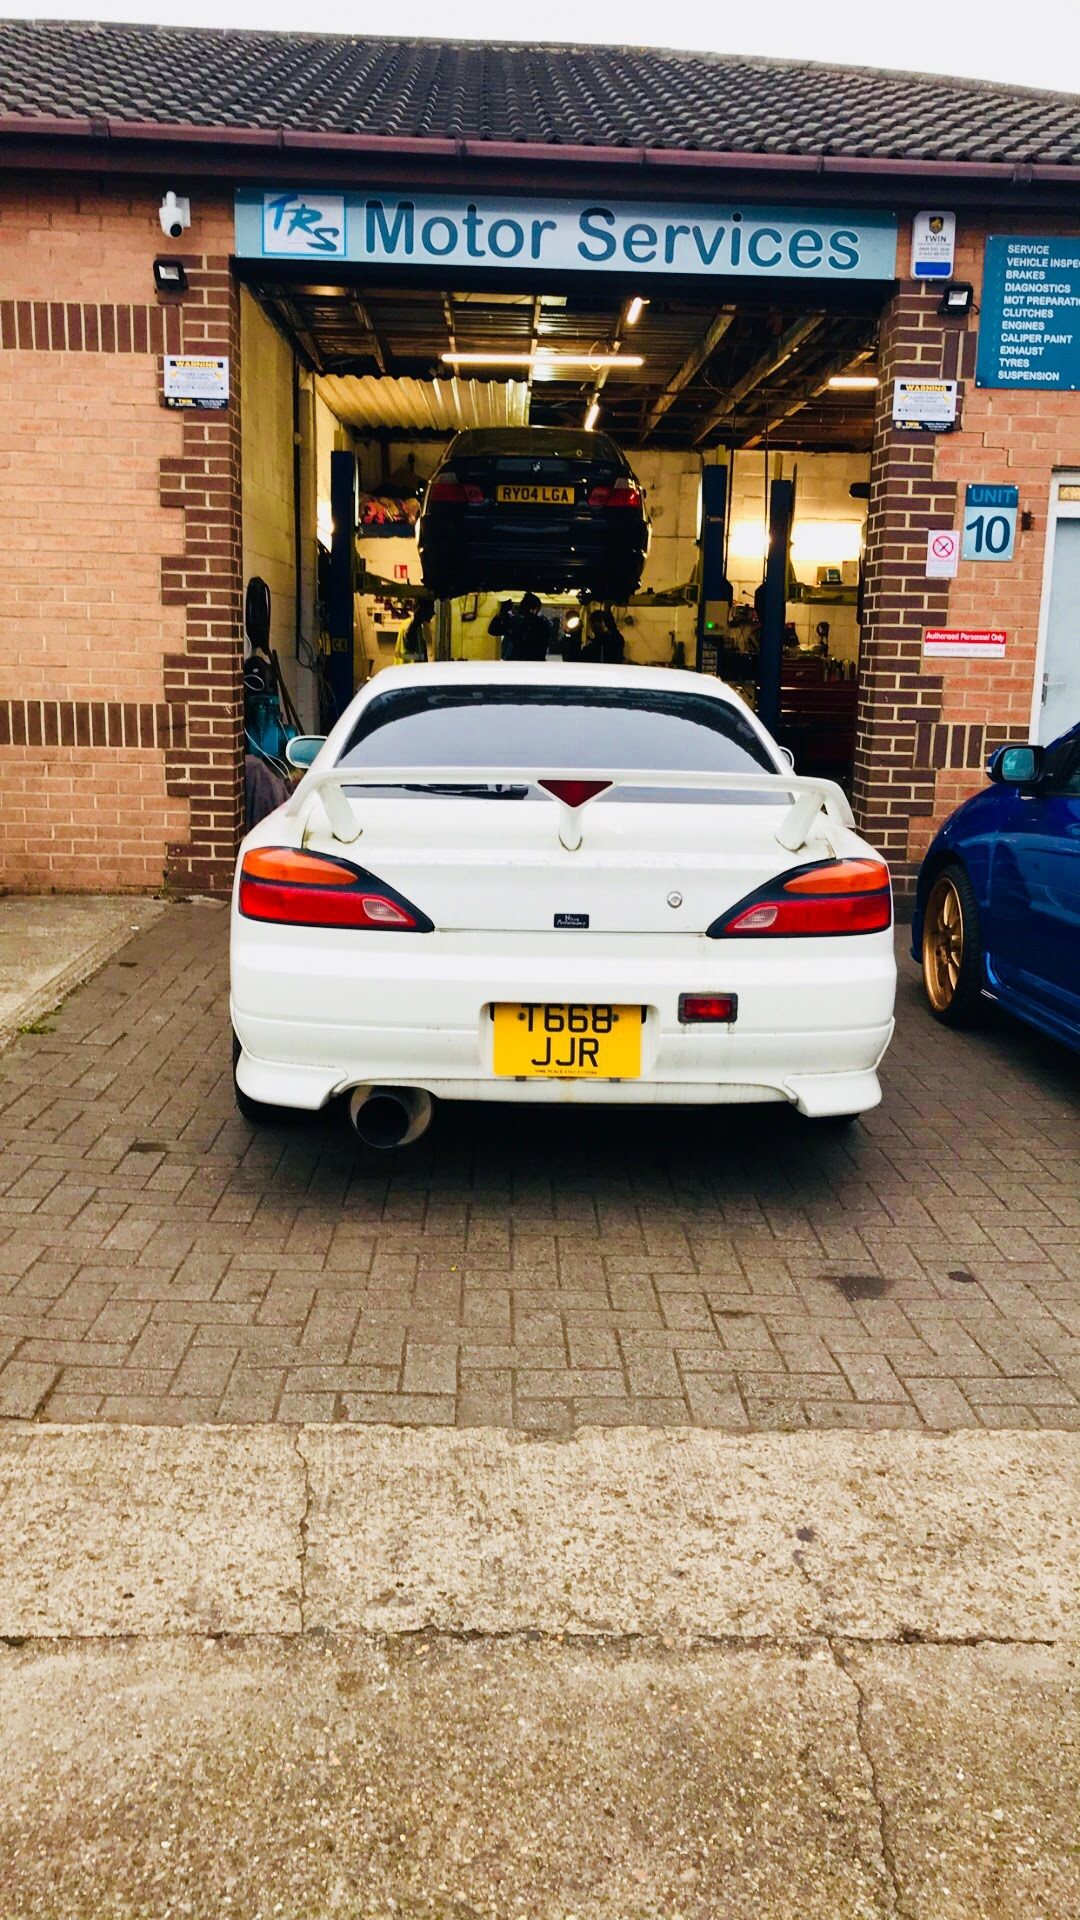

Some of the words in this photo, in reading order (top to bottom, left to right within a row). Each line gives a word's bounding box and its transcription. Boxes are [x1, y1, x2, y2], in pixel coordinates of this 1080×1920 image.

[267, 193, 340, 252] TRS
[365, 199, 557, 259] Motor
[577, 207, 860, 270] Services
[1008, 245, 1049, 255] SERVICE
[1007, 257, 1048, 267] VEHICLE
[1050, 258, 1080, 268] INSPE
[1006, 271, 1045, 280] BRAKES
[1005, 283, 1071, 293] DIAGNOSTICS
[1004, 296, 1023, 305] MOT
[1027, 296, 1080, 306] PREPARATI
[1003, 308, 1054, 318] CLUTCHES
[1002, 321, 1044, 331] ENGINES
[1001, 333, 1042, 343] CALIPER
[1044, 335, 1073, 344] PAINT
[1000, 346, 1044, 356] EXHAUST
[1000, 358, 1030, 368] TYRES
[998, 371, 1059, 381] SUSPENSION
[905, 384, 947, 392] WARNING
[503, 487, 539, 500] RY04
[542, 487, 569, 501] LGA
[972, 488, 1013, 503] UNIT
[966, 515, 1010, 553] 10
[960, 632, 990, 641] Personnel
[991, 633, 1005, 643] Only
[521, 1004, 613, 1033] T668
[531, 1037, 600, 1067] JJR
